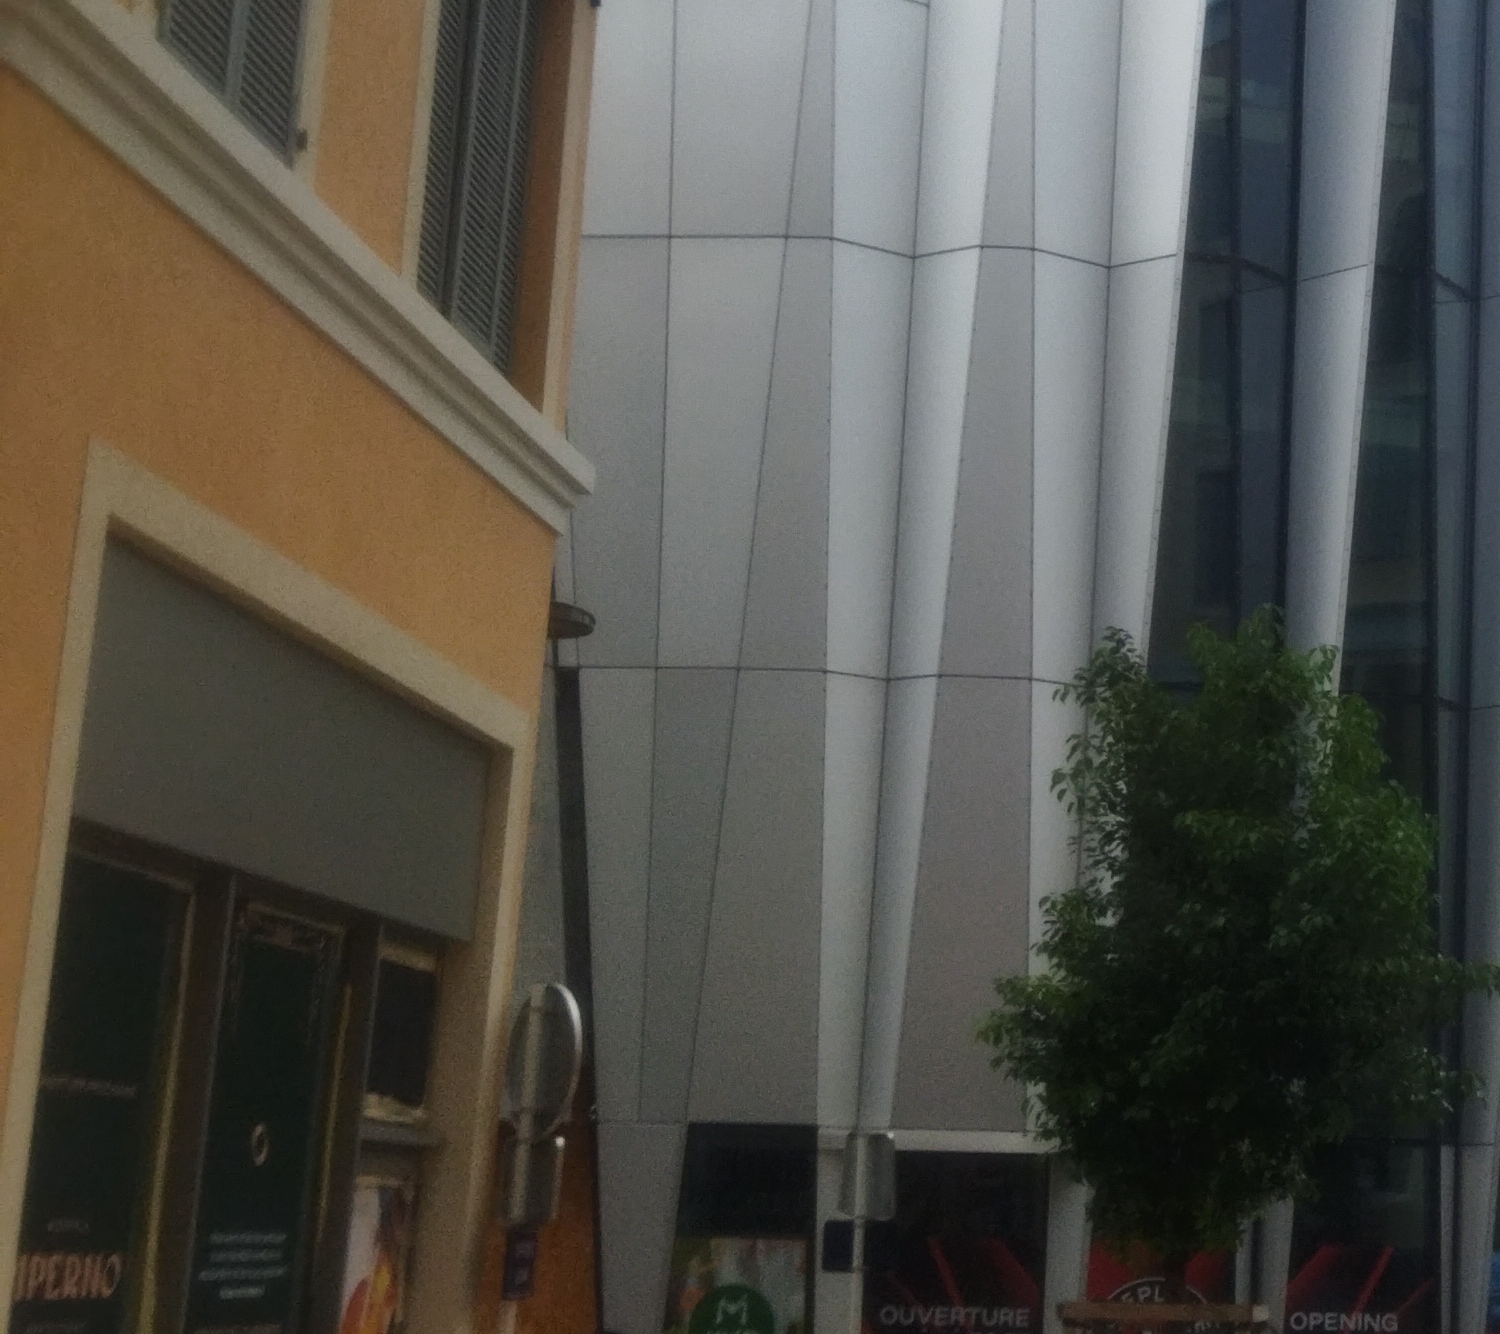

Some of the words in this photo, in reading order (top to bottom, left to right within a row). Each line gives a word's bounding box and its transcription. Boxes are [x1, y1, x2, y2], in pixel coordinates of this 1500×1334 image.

[15, 1253, 123, 1301] IPERNO
[879, 1304, 1031, 1328] OUVERTURE
[1289, 1311, 1399, 1333] OPENING
